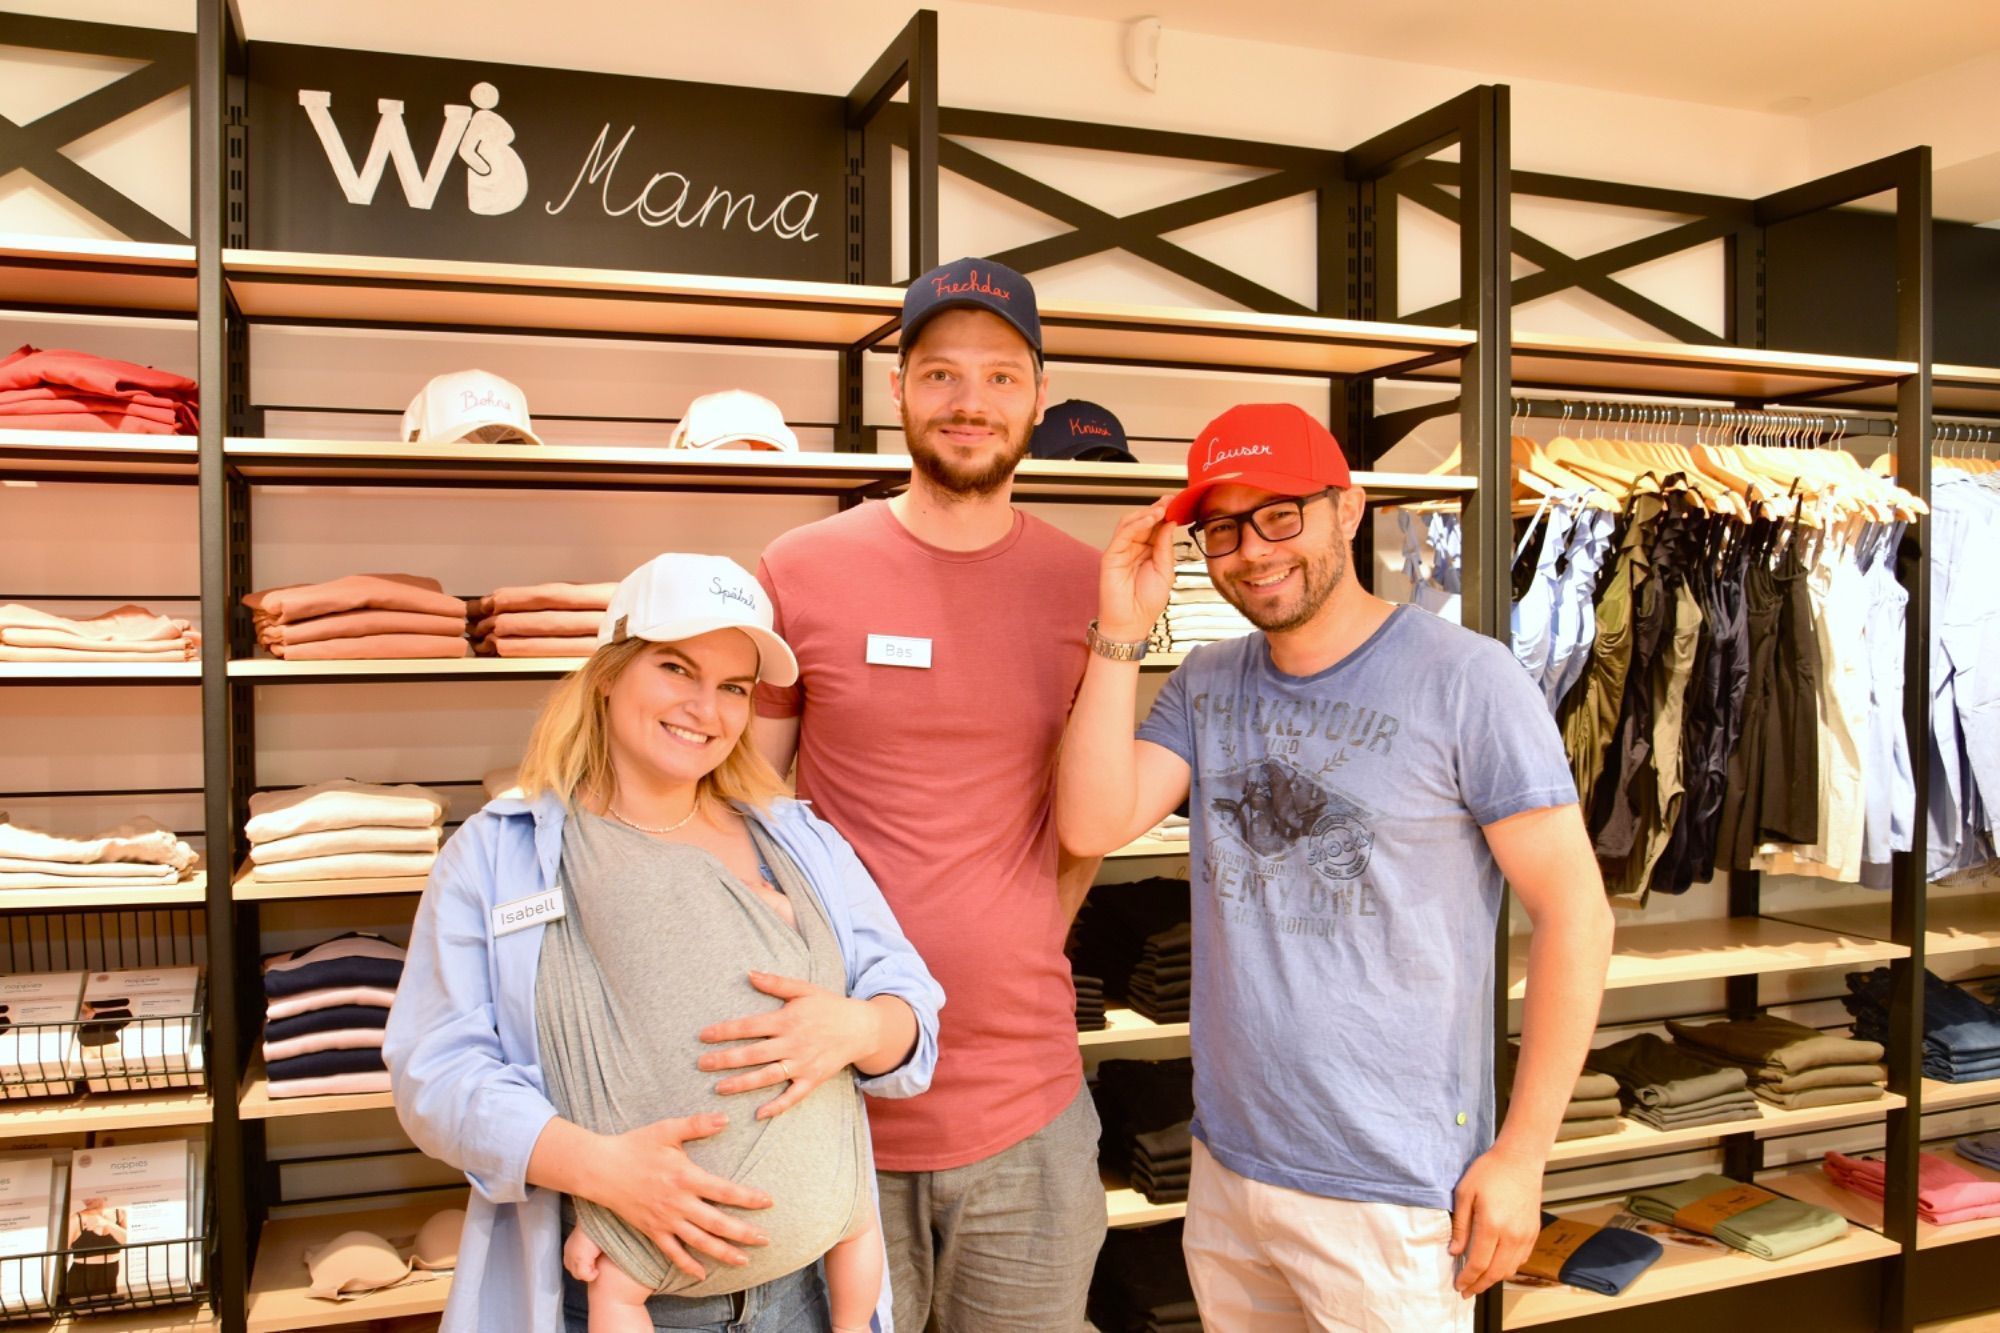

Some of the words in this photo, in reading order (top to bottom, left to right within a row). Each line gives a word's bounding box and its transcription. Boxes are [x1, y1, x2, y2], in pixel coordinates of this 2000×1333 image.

[545, 122, 820, 242] Mama
[1202, 437, 1273, 472] Lauser
[500, 897, 556, 925] Isabell
